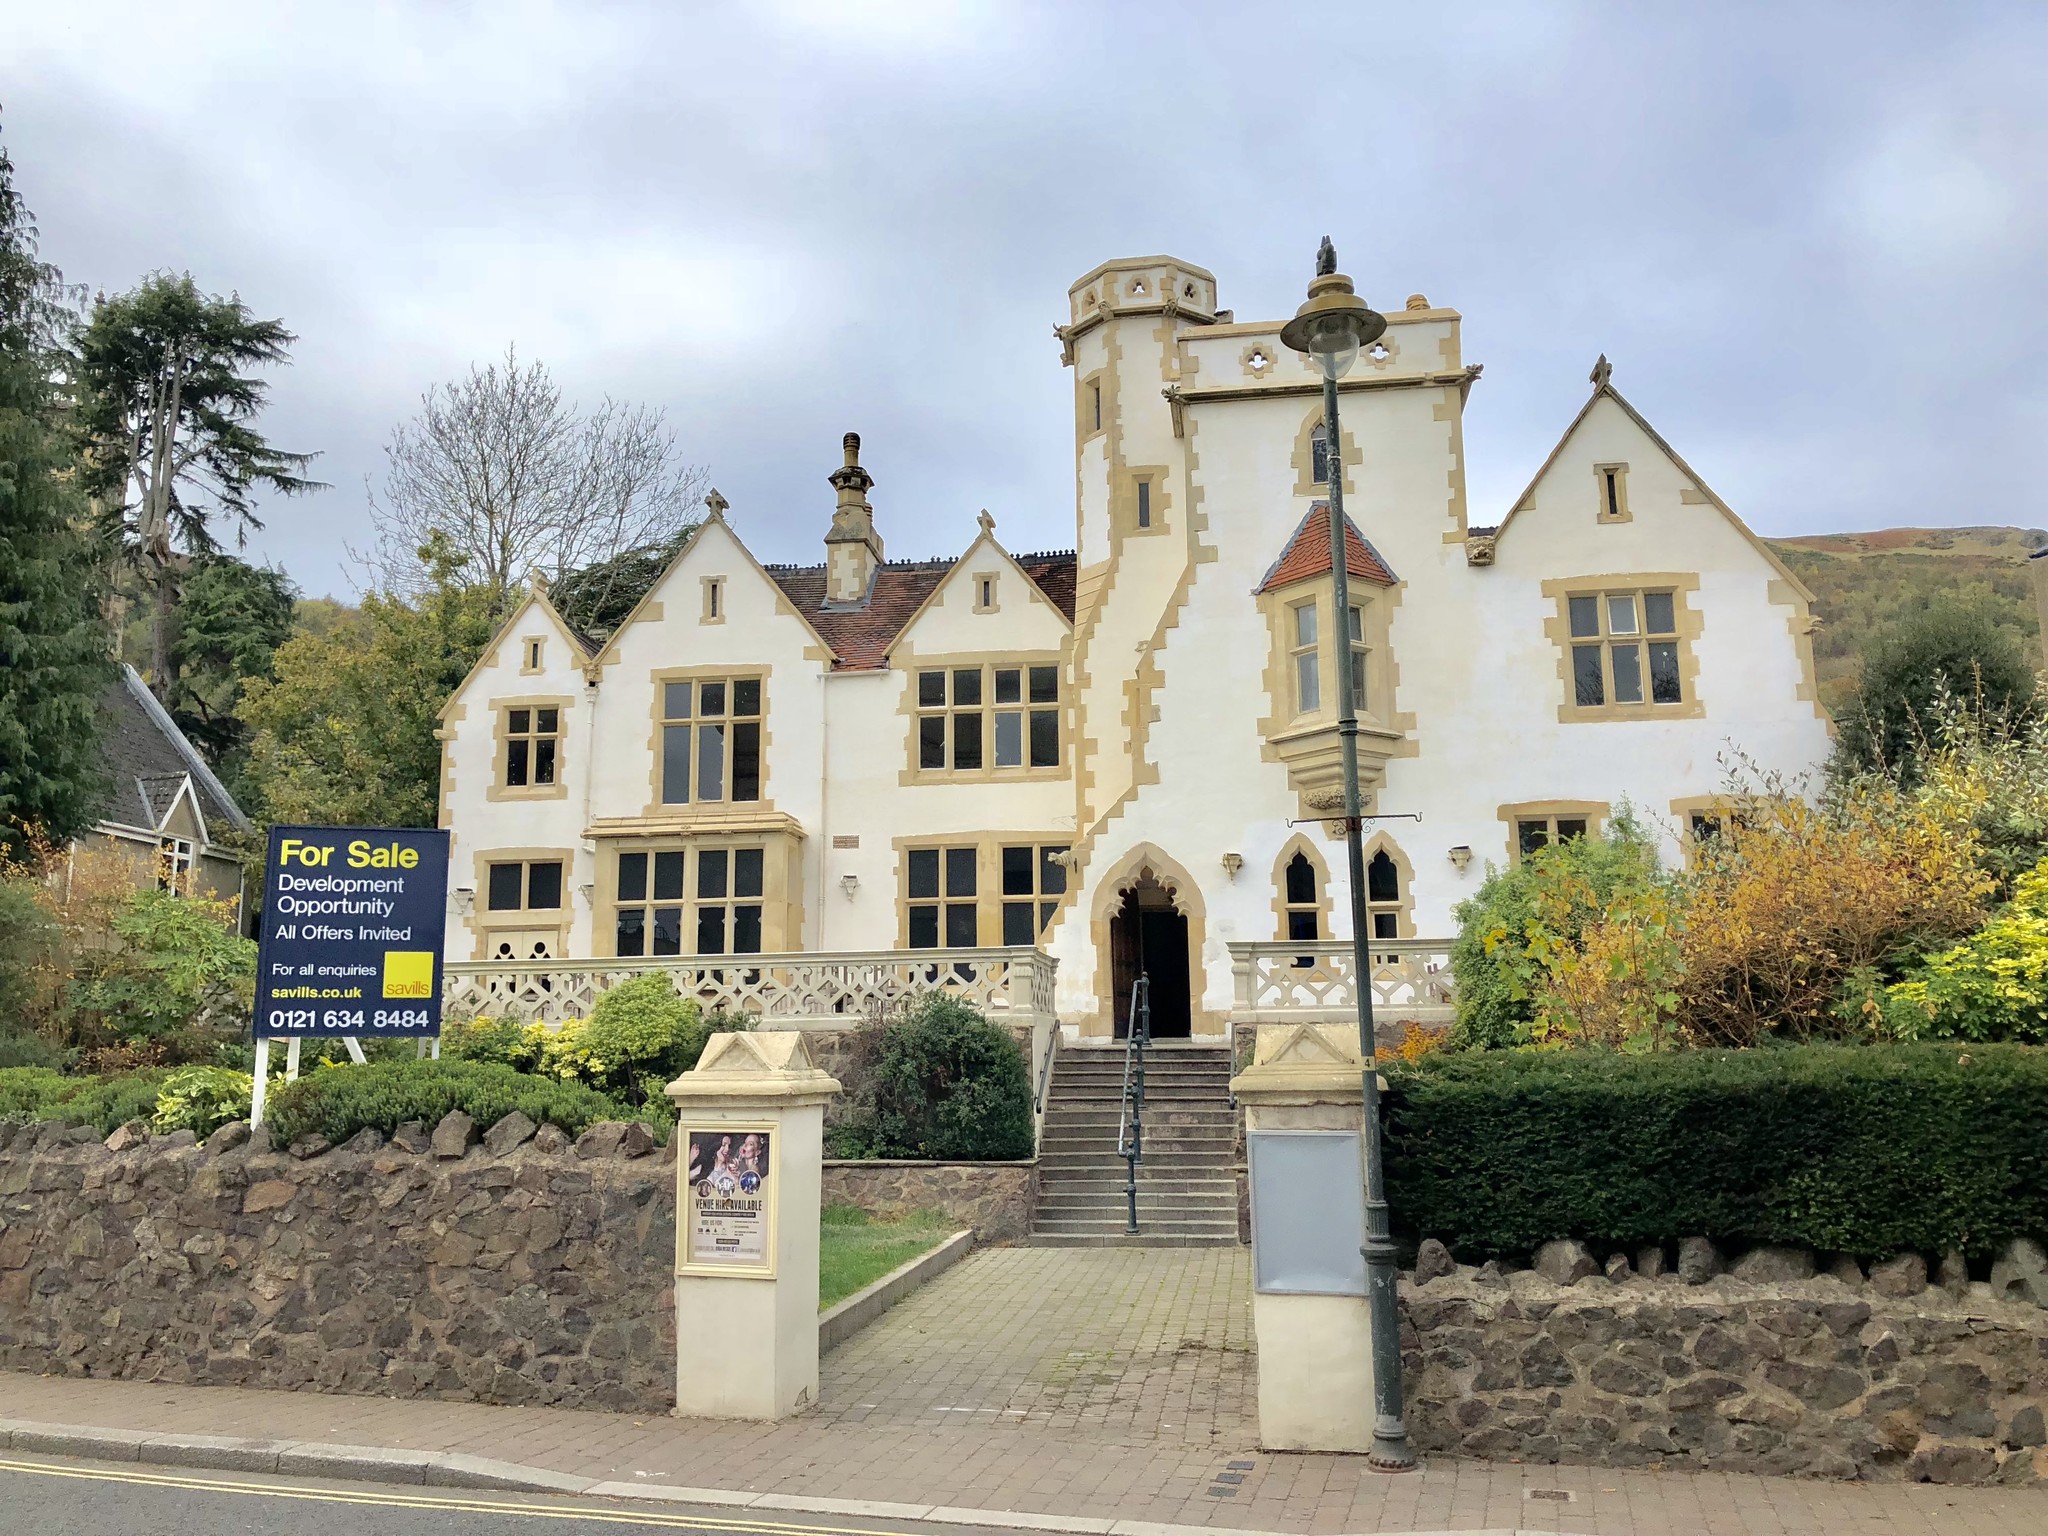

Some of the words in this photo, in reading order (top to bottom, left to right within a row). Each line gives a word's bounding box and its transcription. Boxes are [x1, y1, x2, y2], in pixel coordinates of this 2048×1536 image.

[280, 839, 335, 867] For
[347, 840, 419, 869] Sale
[278, 874, 405, 895] Development
[277, 895, 395, 917] Opportunity
[275, 924, 296, 940] All
[302, 924, 354, 940] Offers
[359, 925, 411, 941] Invited
[272, 963, 294, 976] For
[299, 963, 314, 976] all
[318, 964, 377, 978] enquiries
[271, 986, 362, 999] savills.co.uk
[385, 980, 429, 996] savills
[269, 1010, 316, 1028] 0121
[323, 1010, 365, 1028] 634
[373, 1010, 429, 1028] 8484
[1364, 1058, 1371, 1068] 4
[695, 1198, 715, 1210] VENUE
[730, 1199, 763, 1211] AVAILABLE
